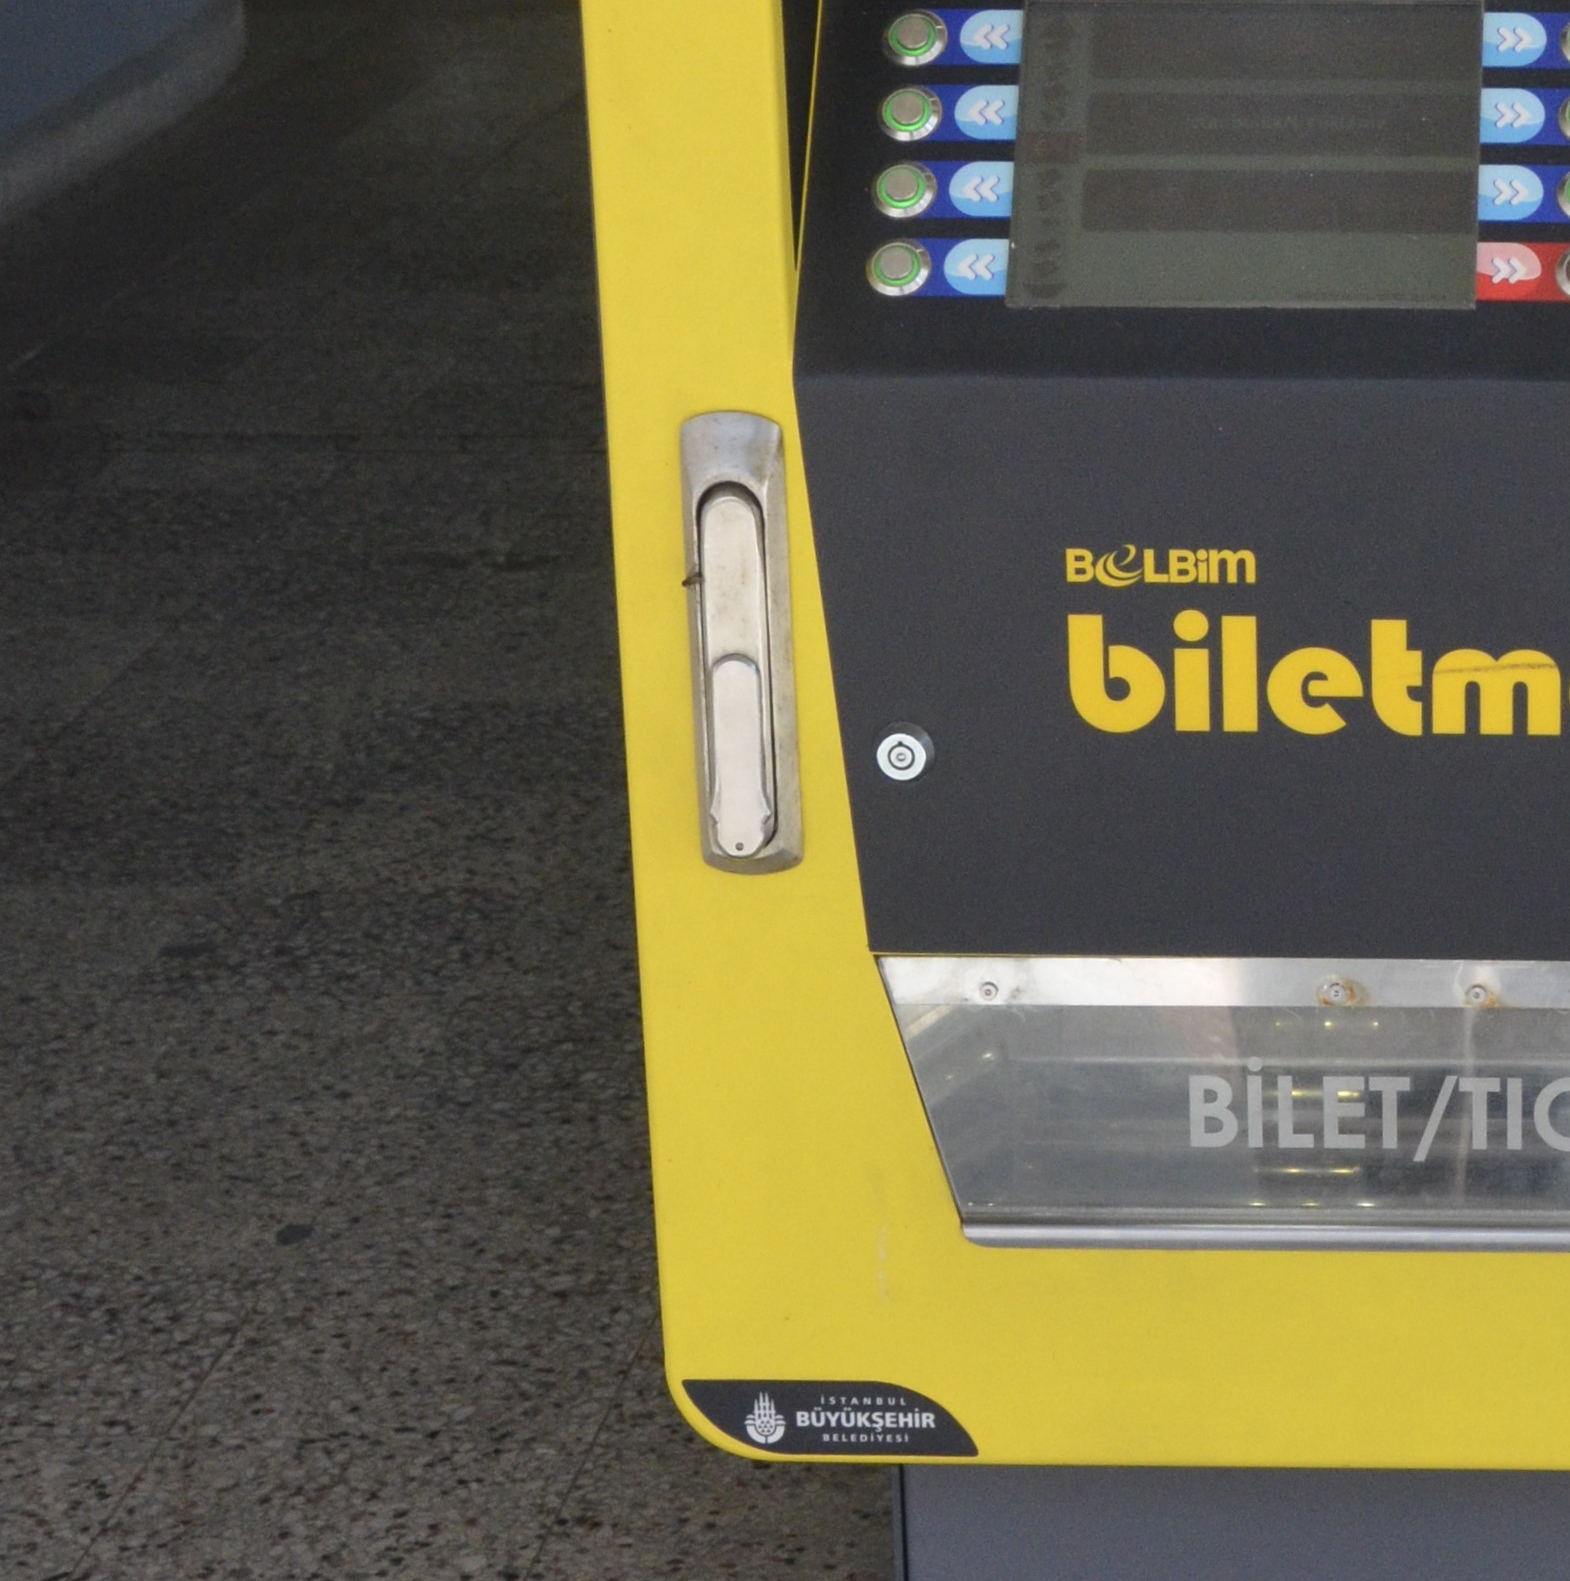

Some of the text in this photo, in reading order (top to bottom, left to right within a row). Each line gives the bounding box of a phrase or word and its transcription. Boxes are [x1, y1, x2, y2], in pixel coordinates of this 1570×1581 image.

[820, 1394, 907, 1407] İSTANBUL
[795, 1406, 937, 1433] BÜYÜKŞEHİR
[821, 1432, 911, 1444] BELEDİYESİ
